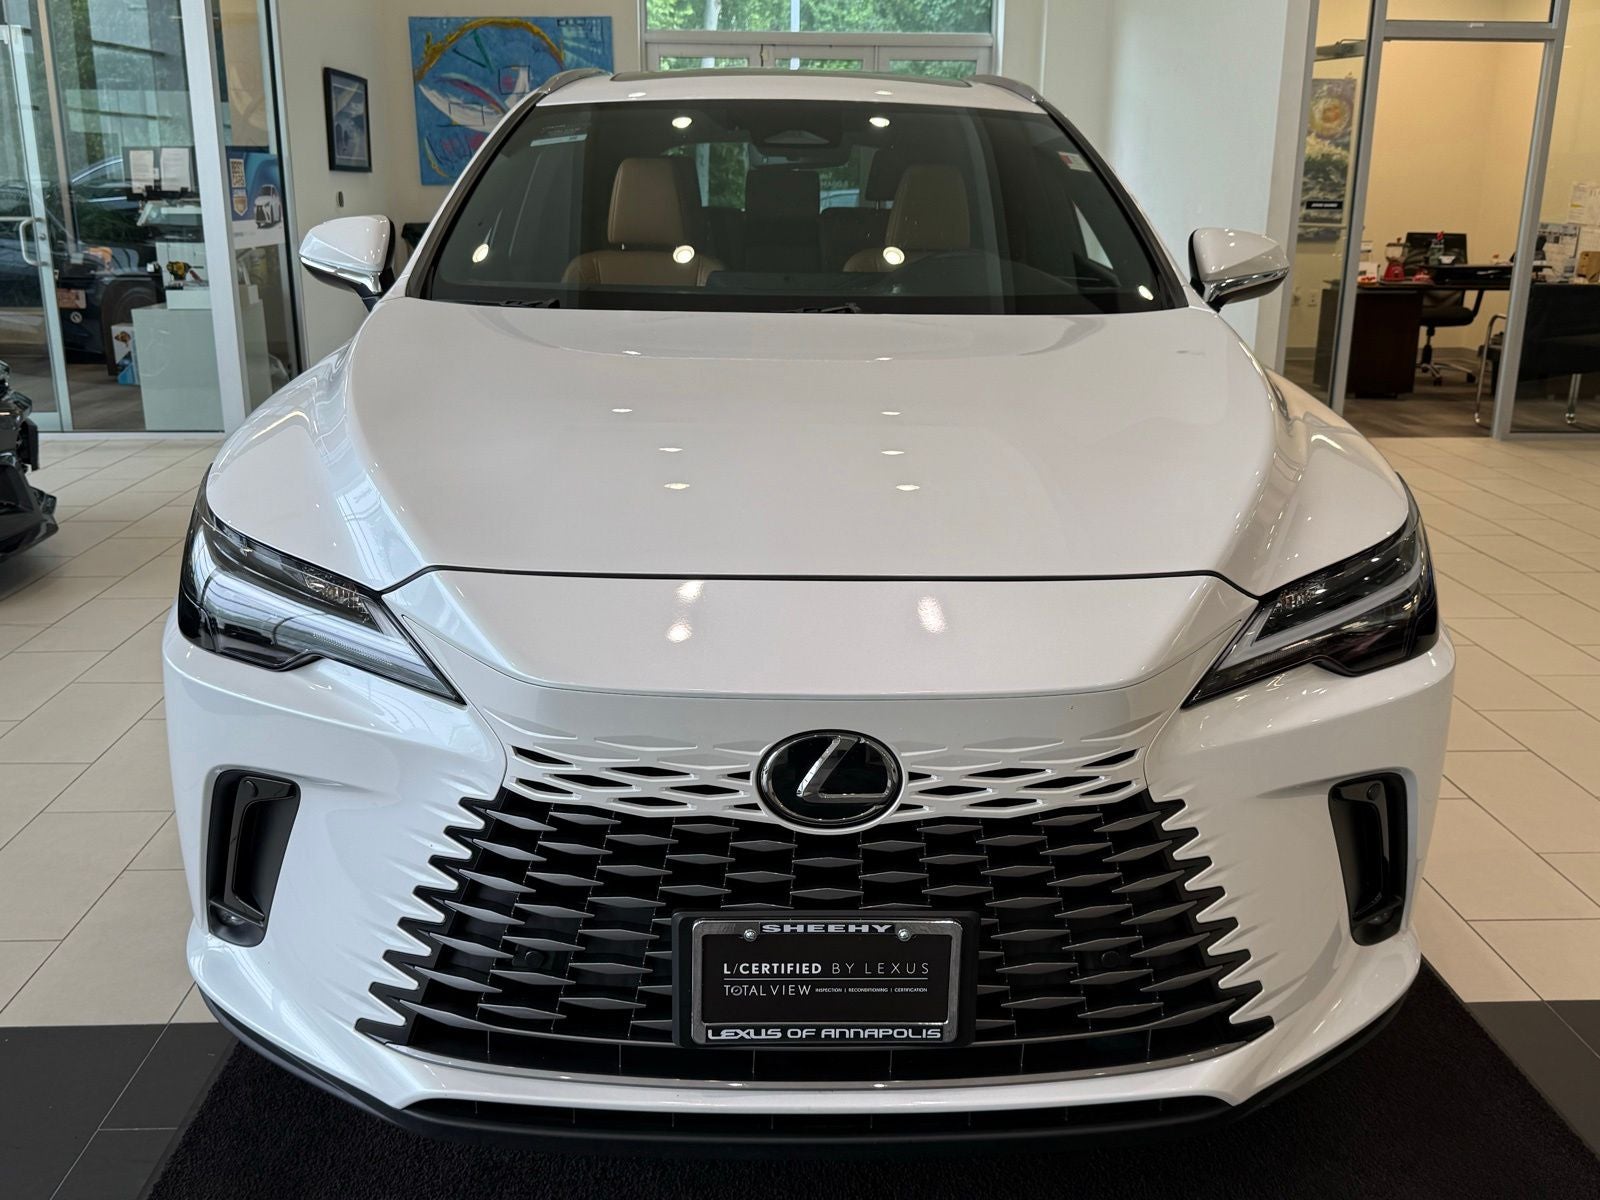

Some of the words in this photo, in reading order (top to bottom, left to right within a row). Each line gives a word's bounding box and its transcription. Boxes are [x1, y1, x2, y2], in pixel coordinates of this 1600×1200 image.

[762, 924, 893, 933] SHEEHY
[723, 962, 822, 975] L/CERTIFIED
[831, 962, 855, 975] BY
[864, 962, 929, 975] LEXUS
[707, 1028, 783, 1040] LEXUS
[786, 1028, 817, 1039] OF
[820, 1028, 941, 1039] ANNAPOLIS
